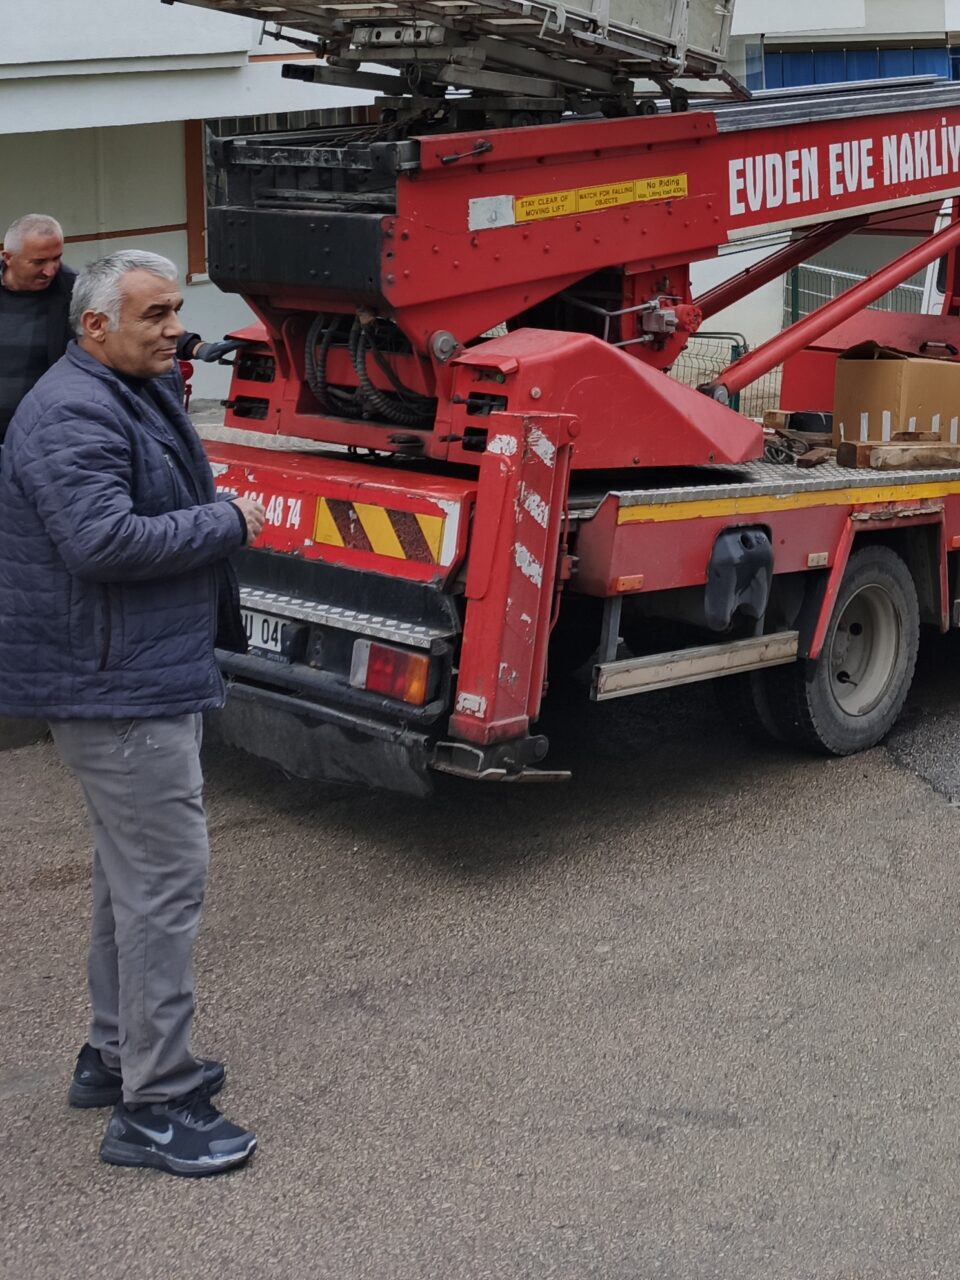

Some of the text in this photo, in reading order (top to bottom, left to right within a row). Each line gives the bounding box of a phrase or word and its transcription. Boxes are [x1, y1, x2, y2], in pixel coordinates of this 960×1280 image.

[728, 146, 819, 216] EVDEN
[829, 137, 875, 196] EVE
[579, 186, 633, 200] WATCH FOR FALLING
[520, 194, 569, 209] STAY CLEAR OF
[595, 196, 618, 207] OBJECTS
[525, 207, 550, 217] MOVING
[265, 495, 284, 527] 48
[285, 498, 302, 530] 74
[261, 618, 287, 648] 04
